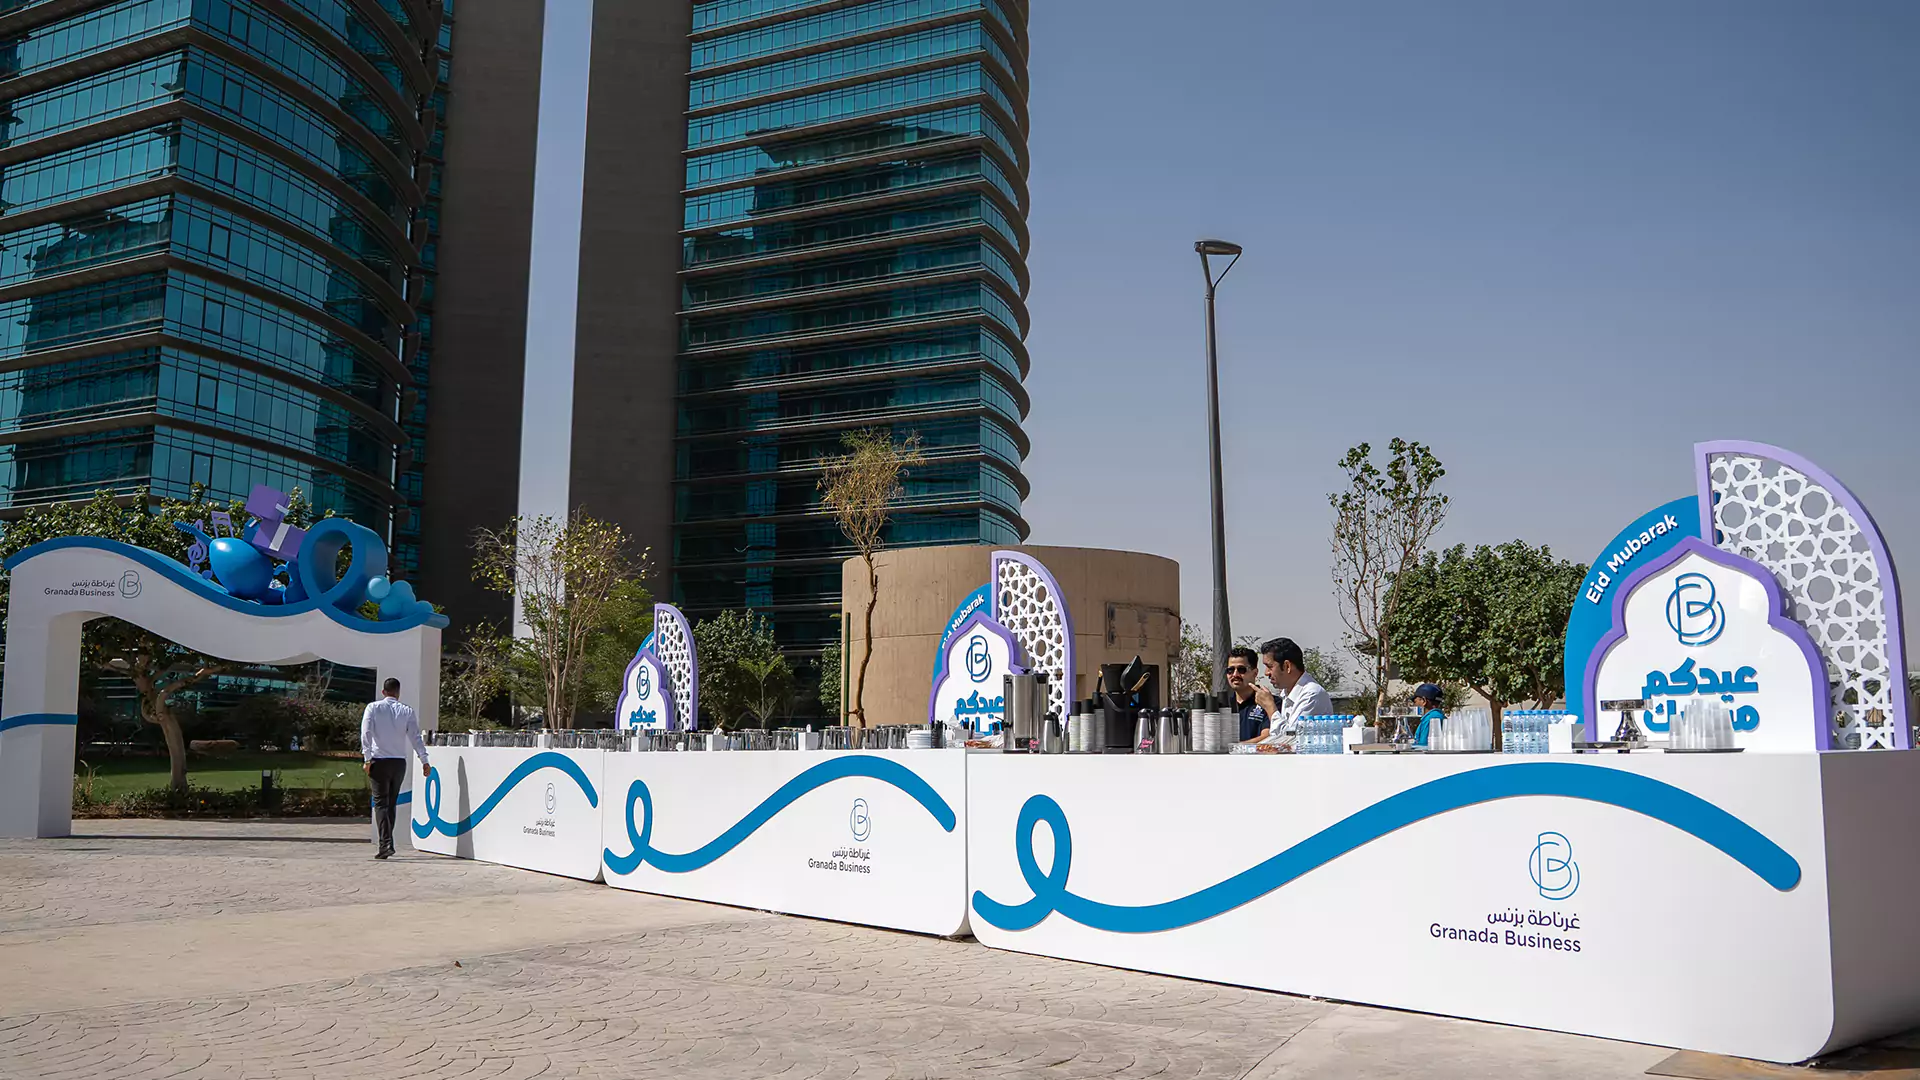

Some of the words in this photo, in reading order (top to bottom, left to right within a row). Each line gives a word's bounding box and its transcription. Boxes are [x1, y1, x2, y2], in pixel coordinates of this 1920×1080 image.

[1585, 571, 1612, 604] Eid
[1606, 514, 1679, 574] Mubarak
[44, 587, 79, 596] Granada
[79, 588, 115, 597] Business
[951, 593, 985, 632] Mubarak
[1641, 656, 1760, 702] عيدكم
[808, 857, 838, 871] Granada
[838, 860, 871, 874] Business
[1487, 907, 1525, 928] بزنس
[1527, 908, 1581, 932] غرناطة
[1429, 922, 1499, 944] Granada
[1504, 929, 1582, 953] Business
